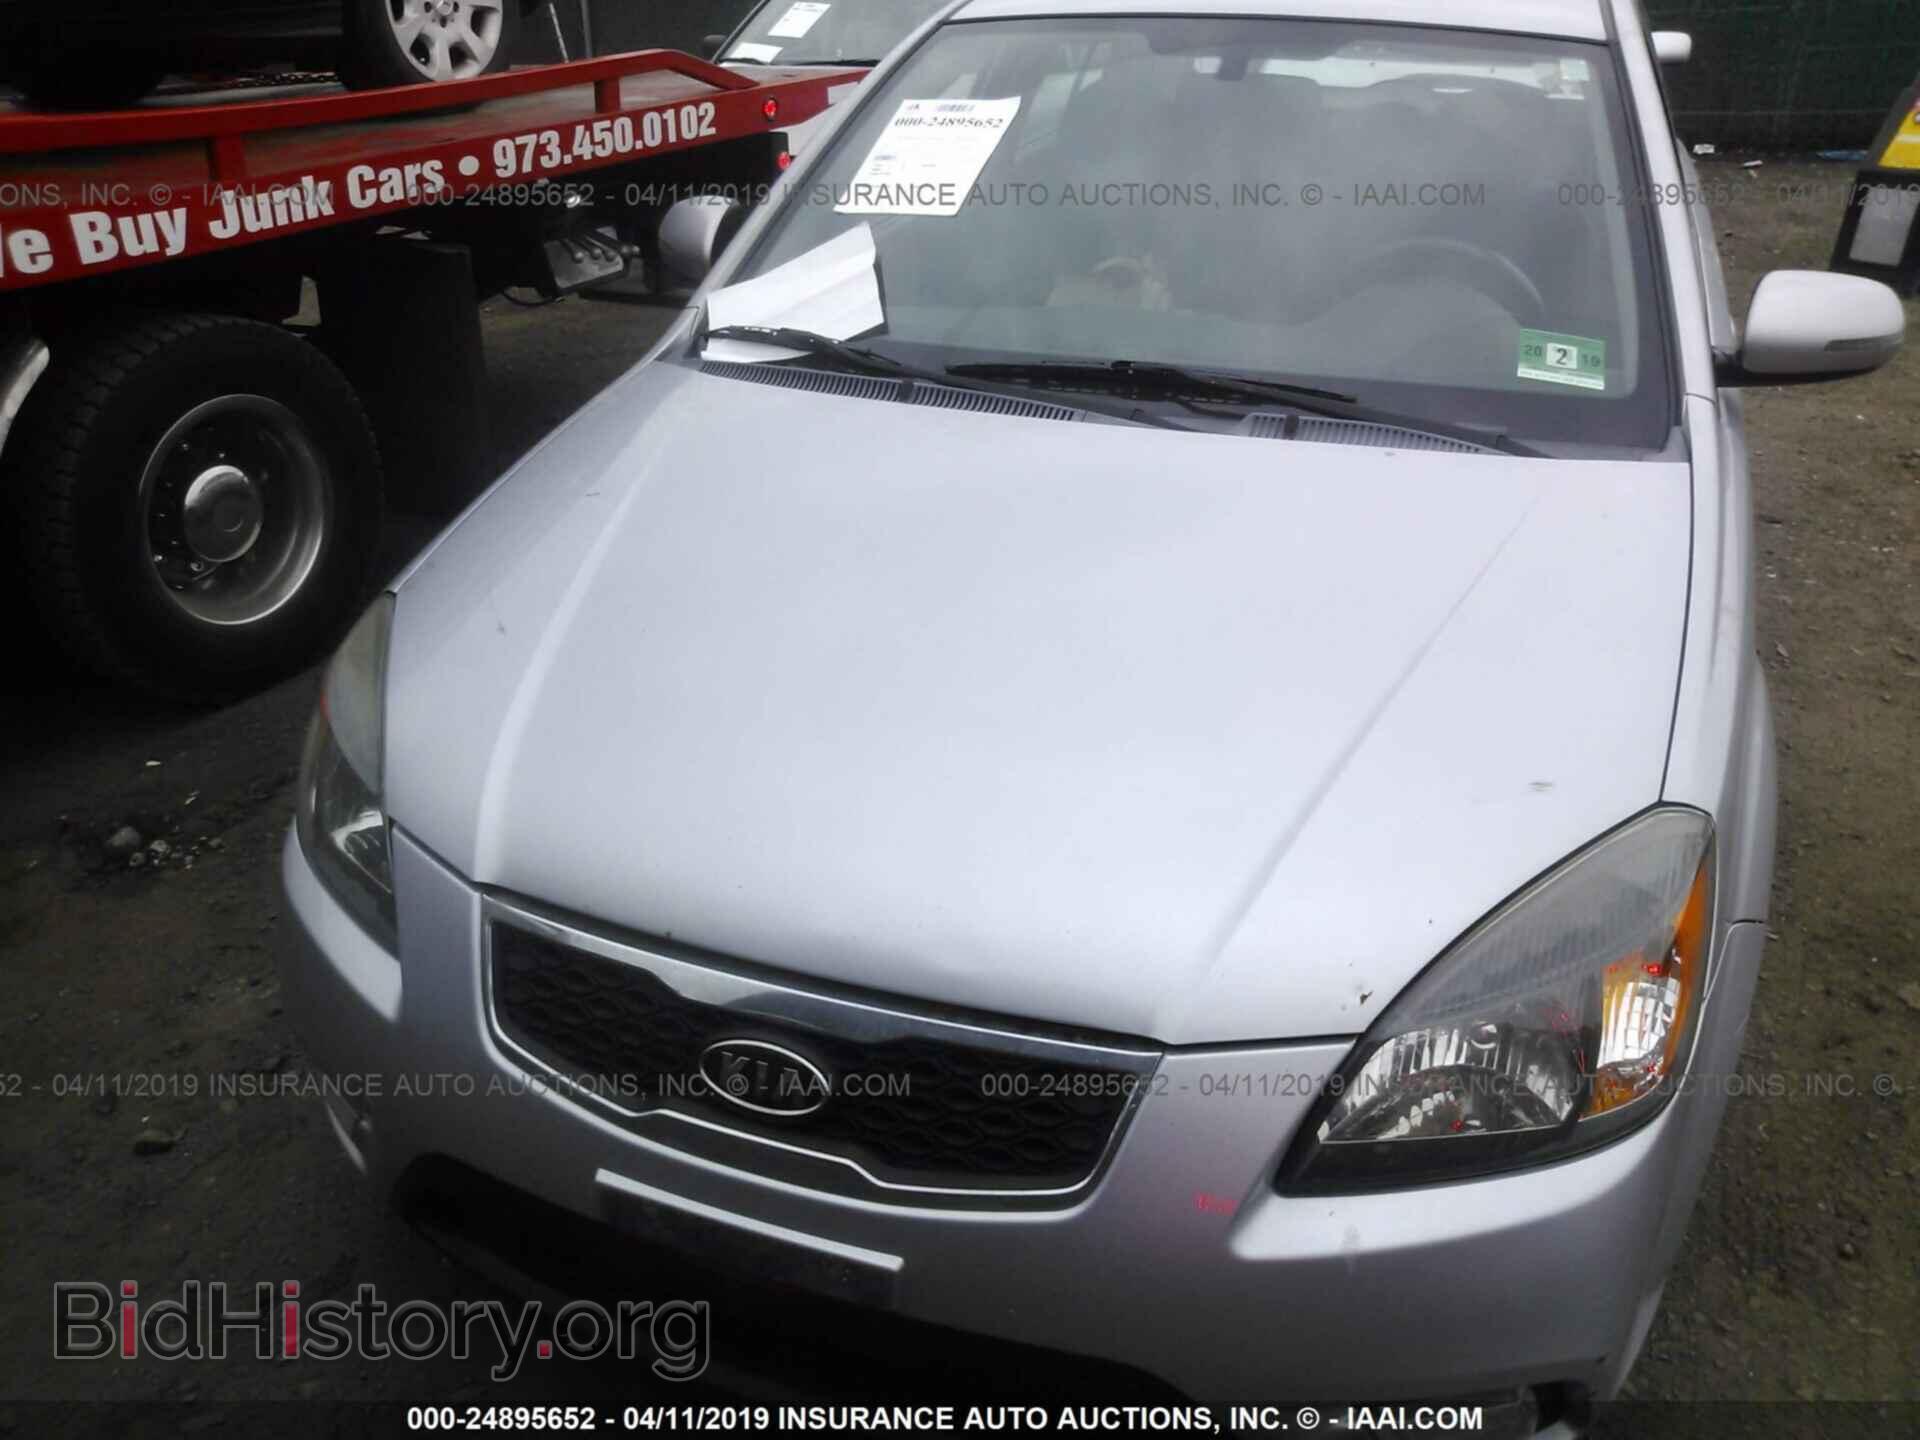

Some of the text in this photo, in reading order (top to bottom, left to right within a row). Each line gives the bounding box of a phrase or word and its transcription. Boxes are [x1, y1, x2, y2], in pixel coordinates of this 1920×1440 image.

[894, 116, 1004, 129] 000-24895652
[0, 101, 717, 279] e Buy Junk Cars 973.450.0102
[1556, 347, 1568, 366] 2
[719, 1050, 806, 1105] KIA
